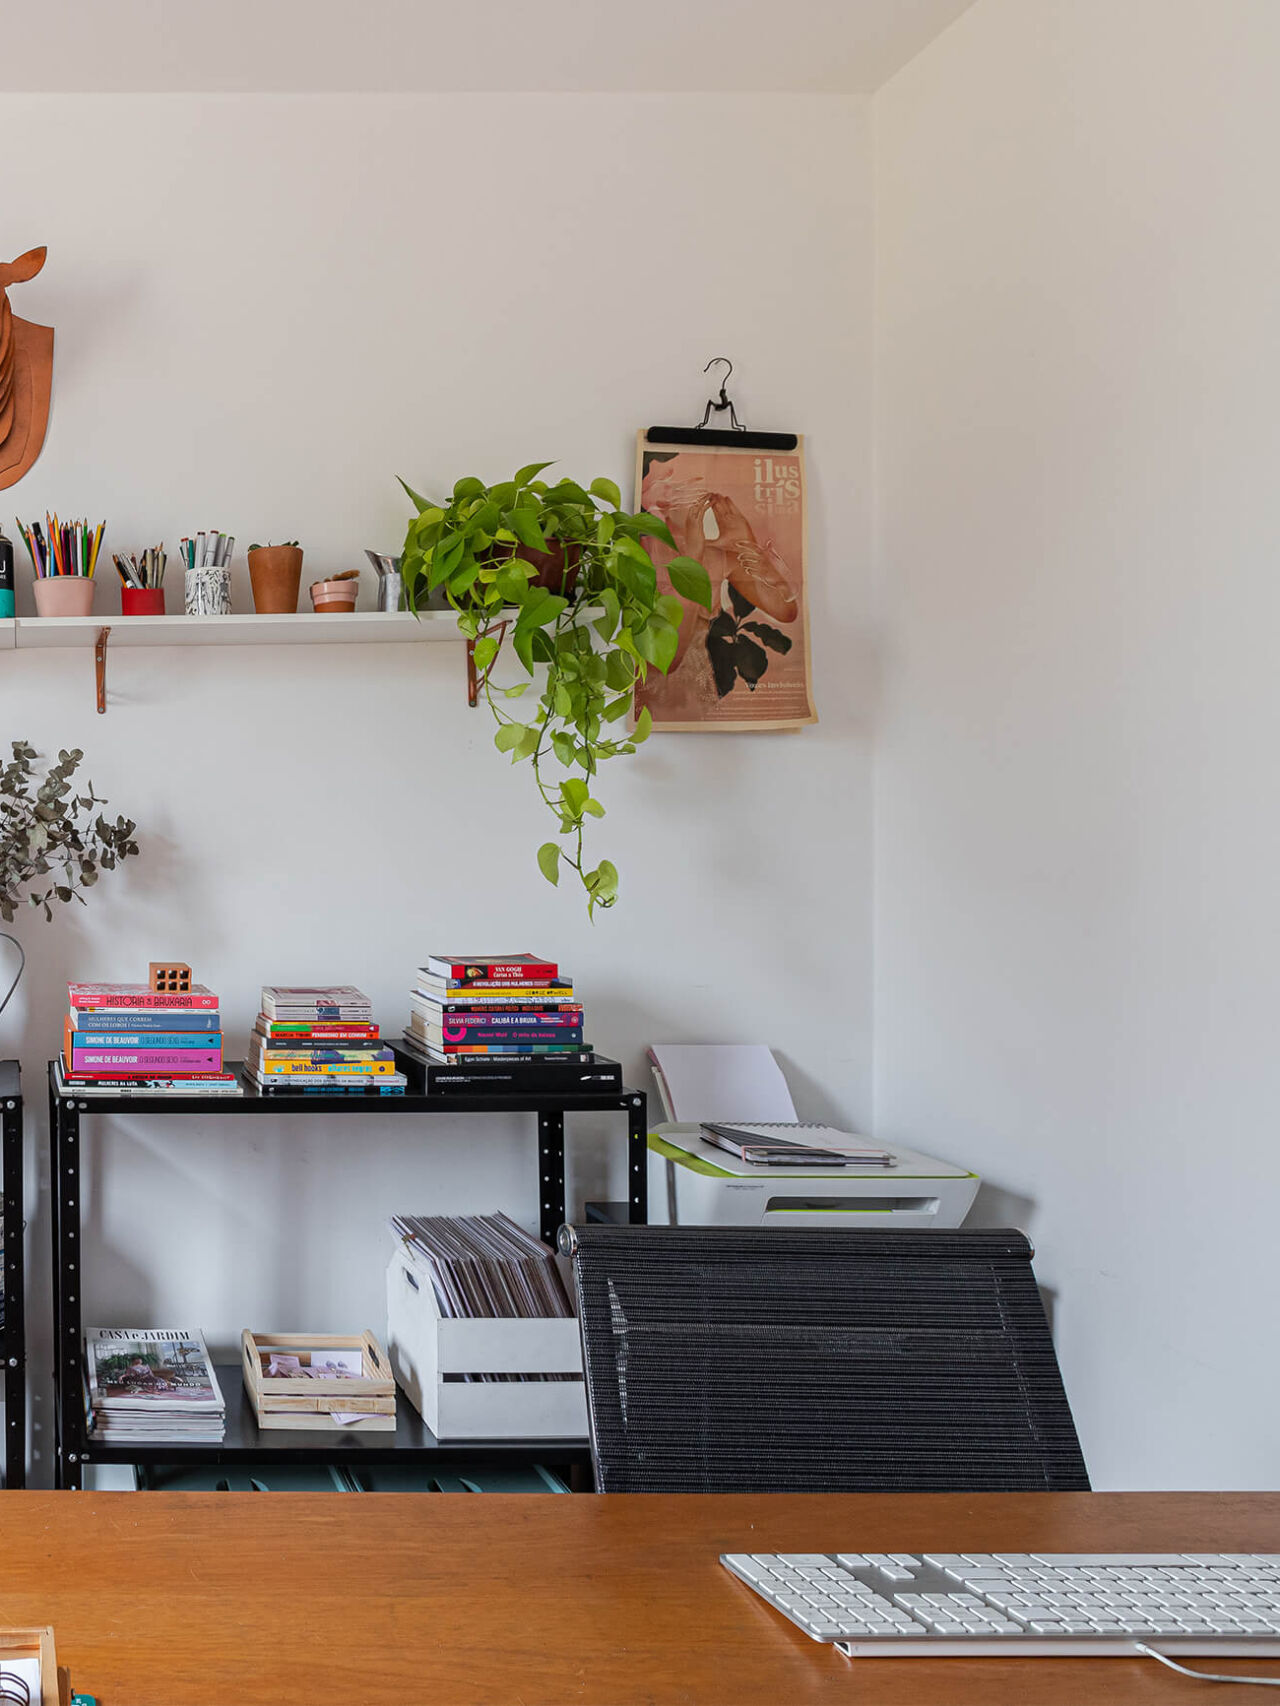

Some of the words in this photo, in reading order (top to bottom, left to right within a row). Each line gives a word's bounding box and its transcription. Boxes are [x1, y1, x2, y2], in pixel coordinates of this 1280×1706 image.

[754, 458, 798, 483] ilus
[292, 1064, 303, 1072] bell
[304, 1064, 322, 1072] hooks
[100, 1330, 129, 1340] CASA
[132, 1332, 139, 1340] e
[141, 1331, 190, 1341] JARDIM
